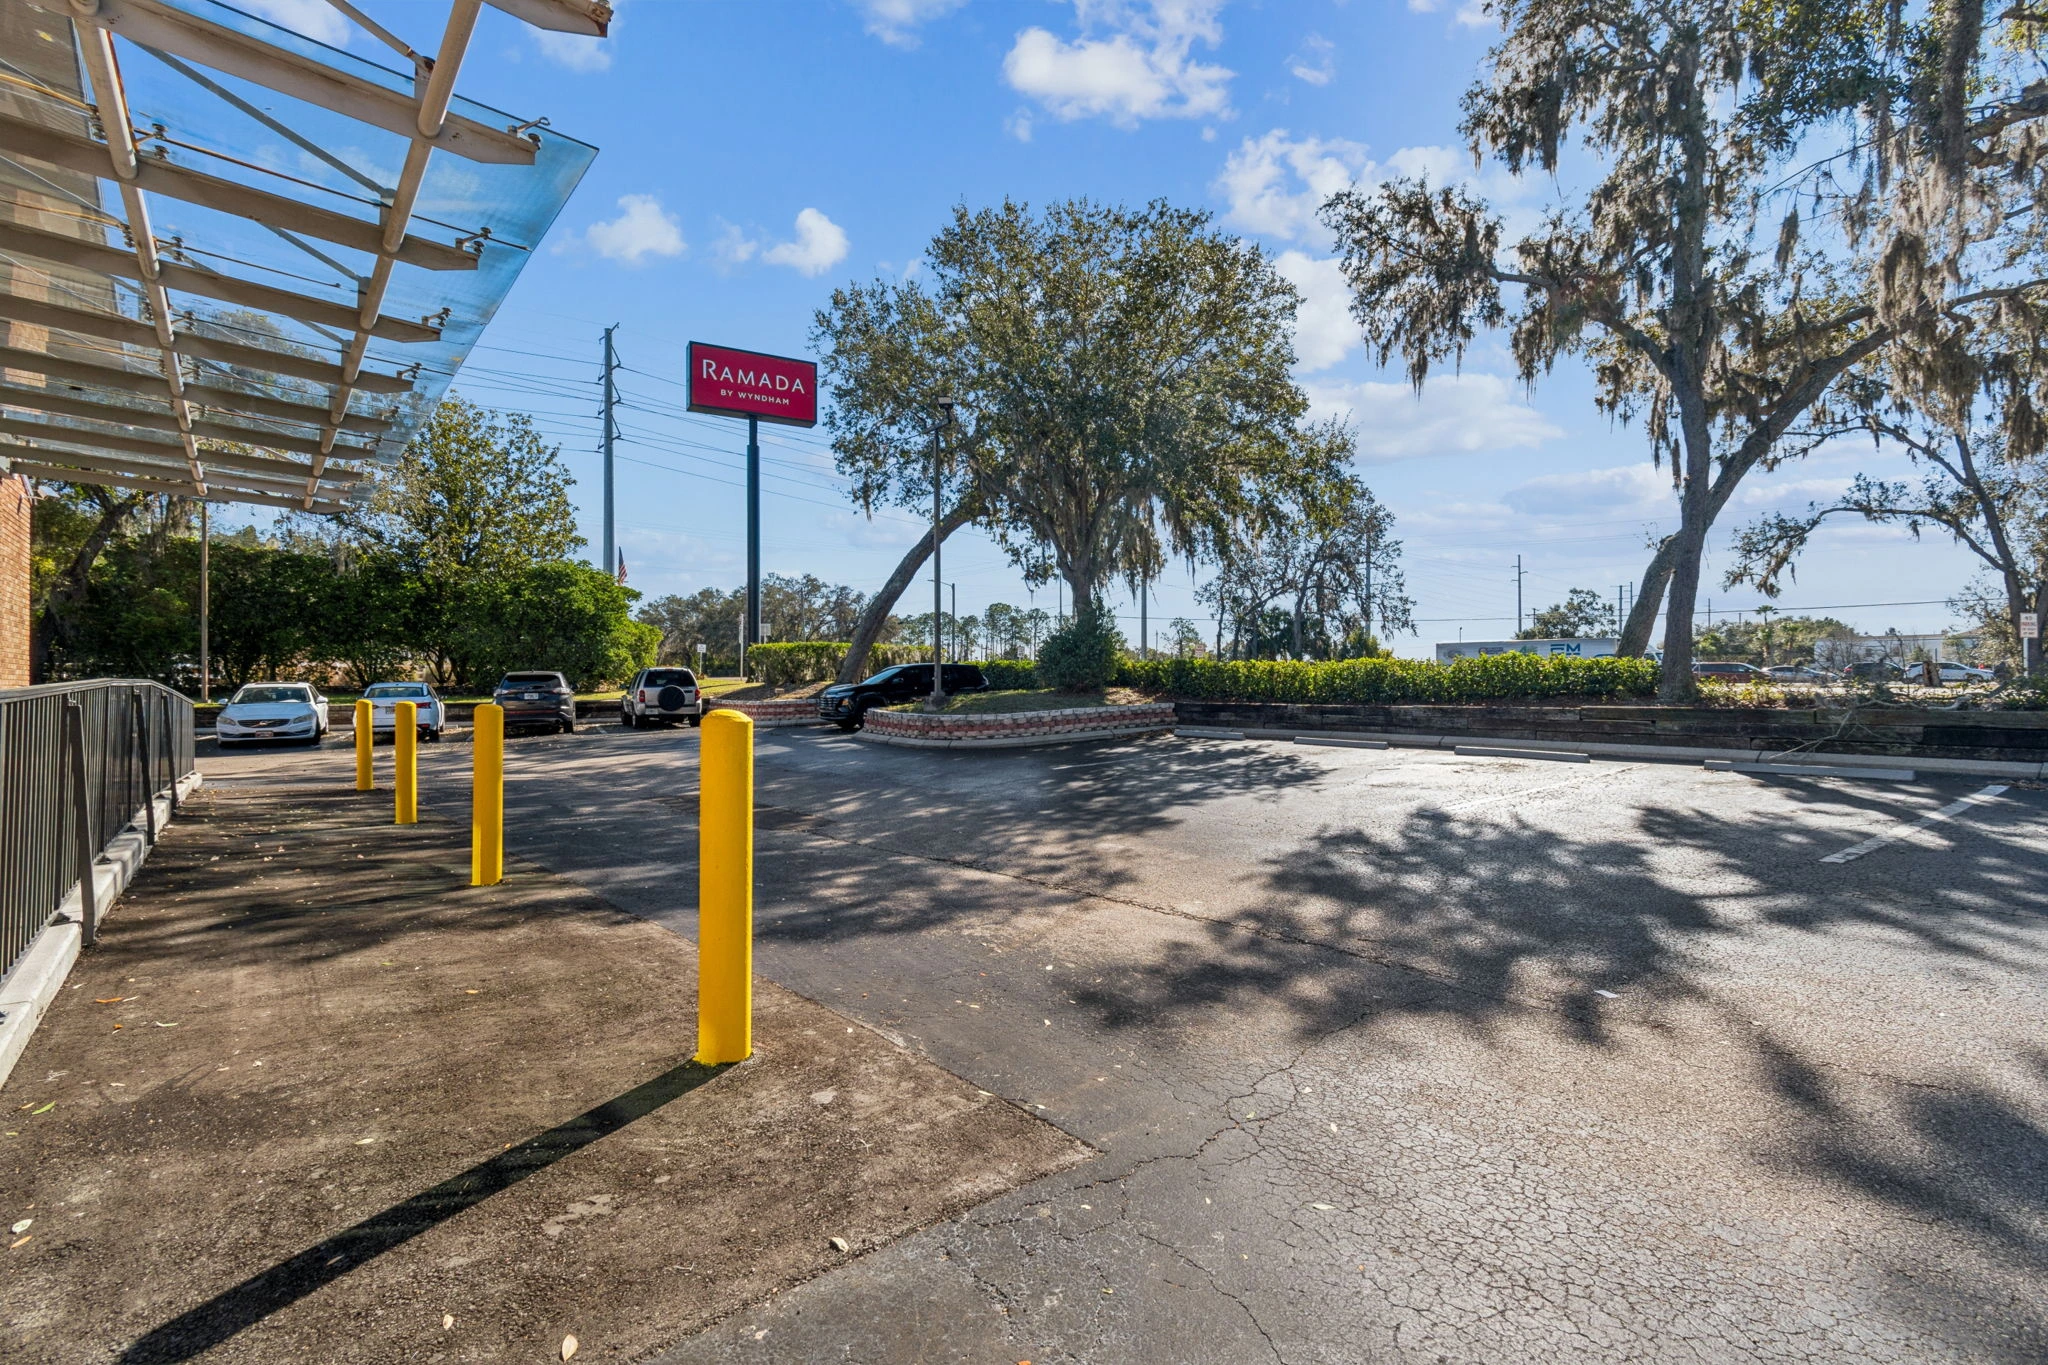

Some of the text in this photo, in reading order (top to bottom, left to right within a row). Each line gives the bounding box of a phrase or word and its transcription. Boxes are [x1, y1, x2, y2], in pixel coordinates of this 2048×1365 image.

[702, 359, 805, 394] RAMADA
[720, 389, 790, 405] BY WYNDHAM
